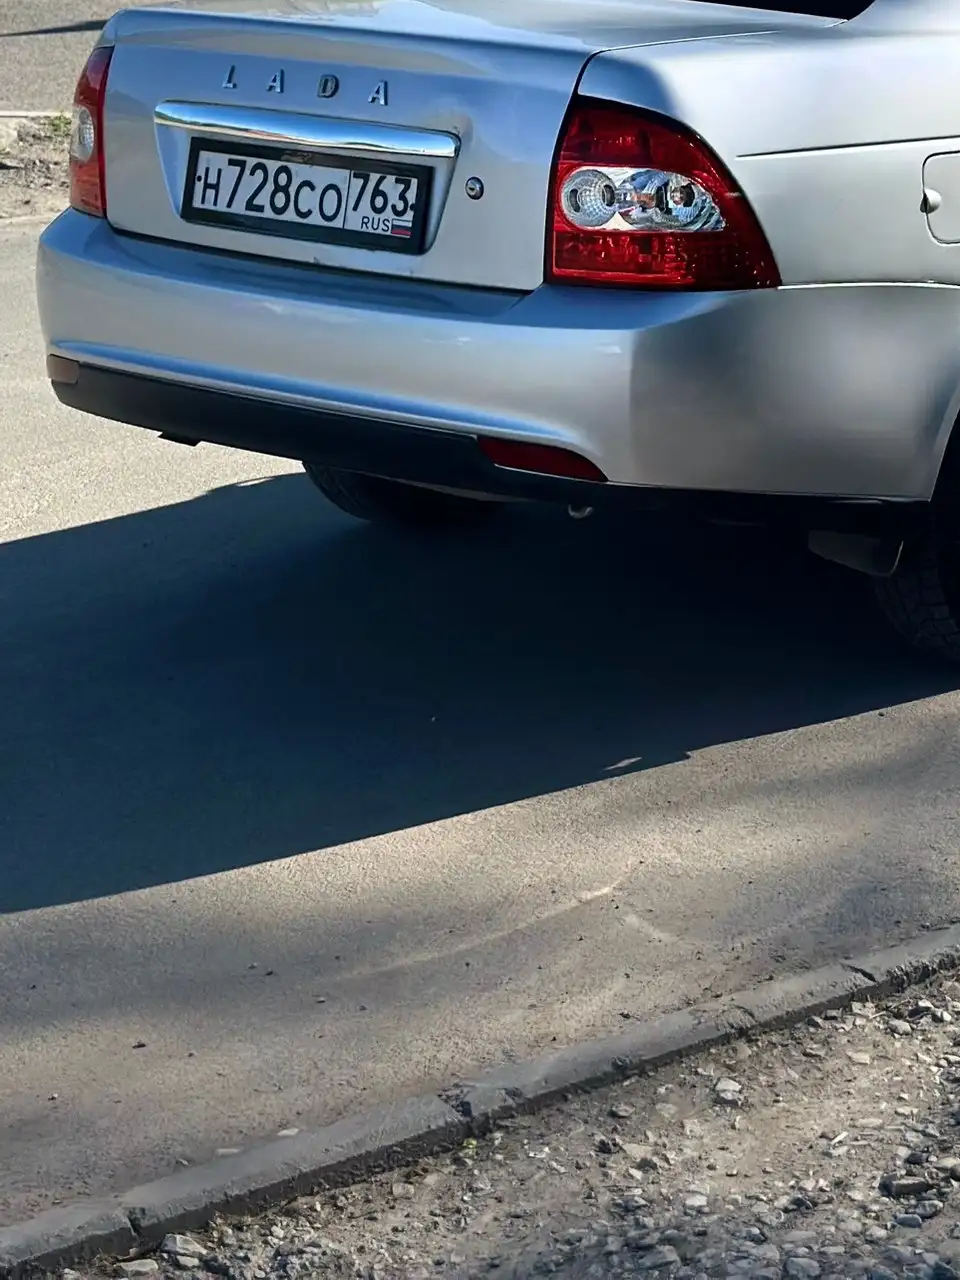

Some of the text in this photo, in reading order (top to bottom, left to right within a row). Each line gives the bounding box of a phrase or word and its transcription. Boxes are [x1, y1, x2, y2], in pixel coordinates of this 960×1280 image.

[222, 64, 389, 106] LADA
[352, 172, 412, 217] 763
[360, 215, 390, 233] RUS
